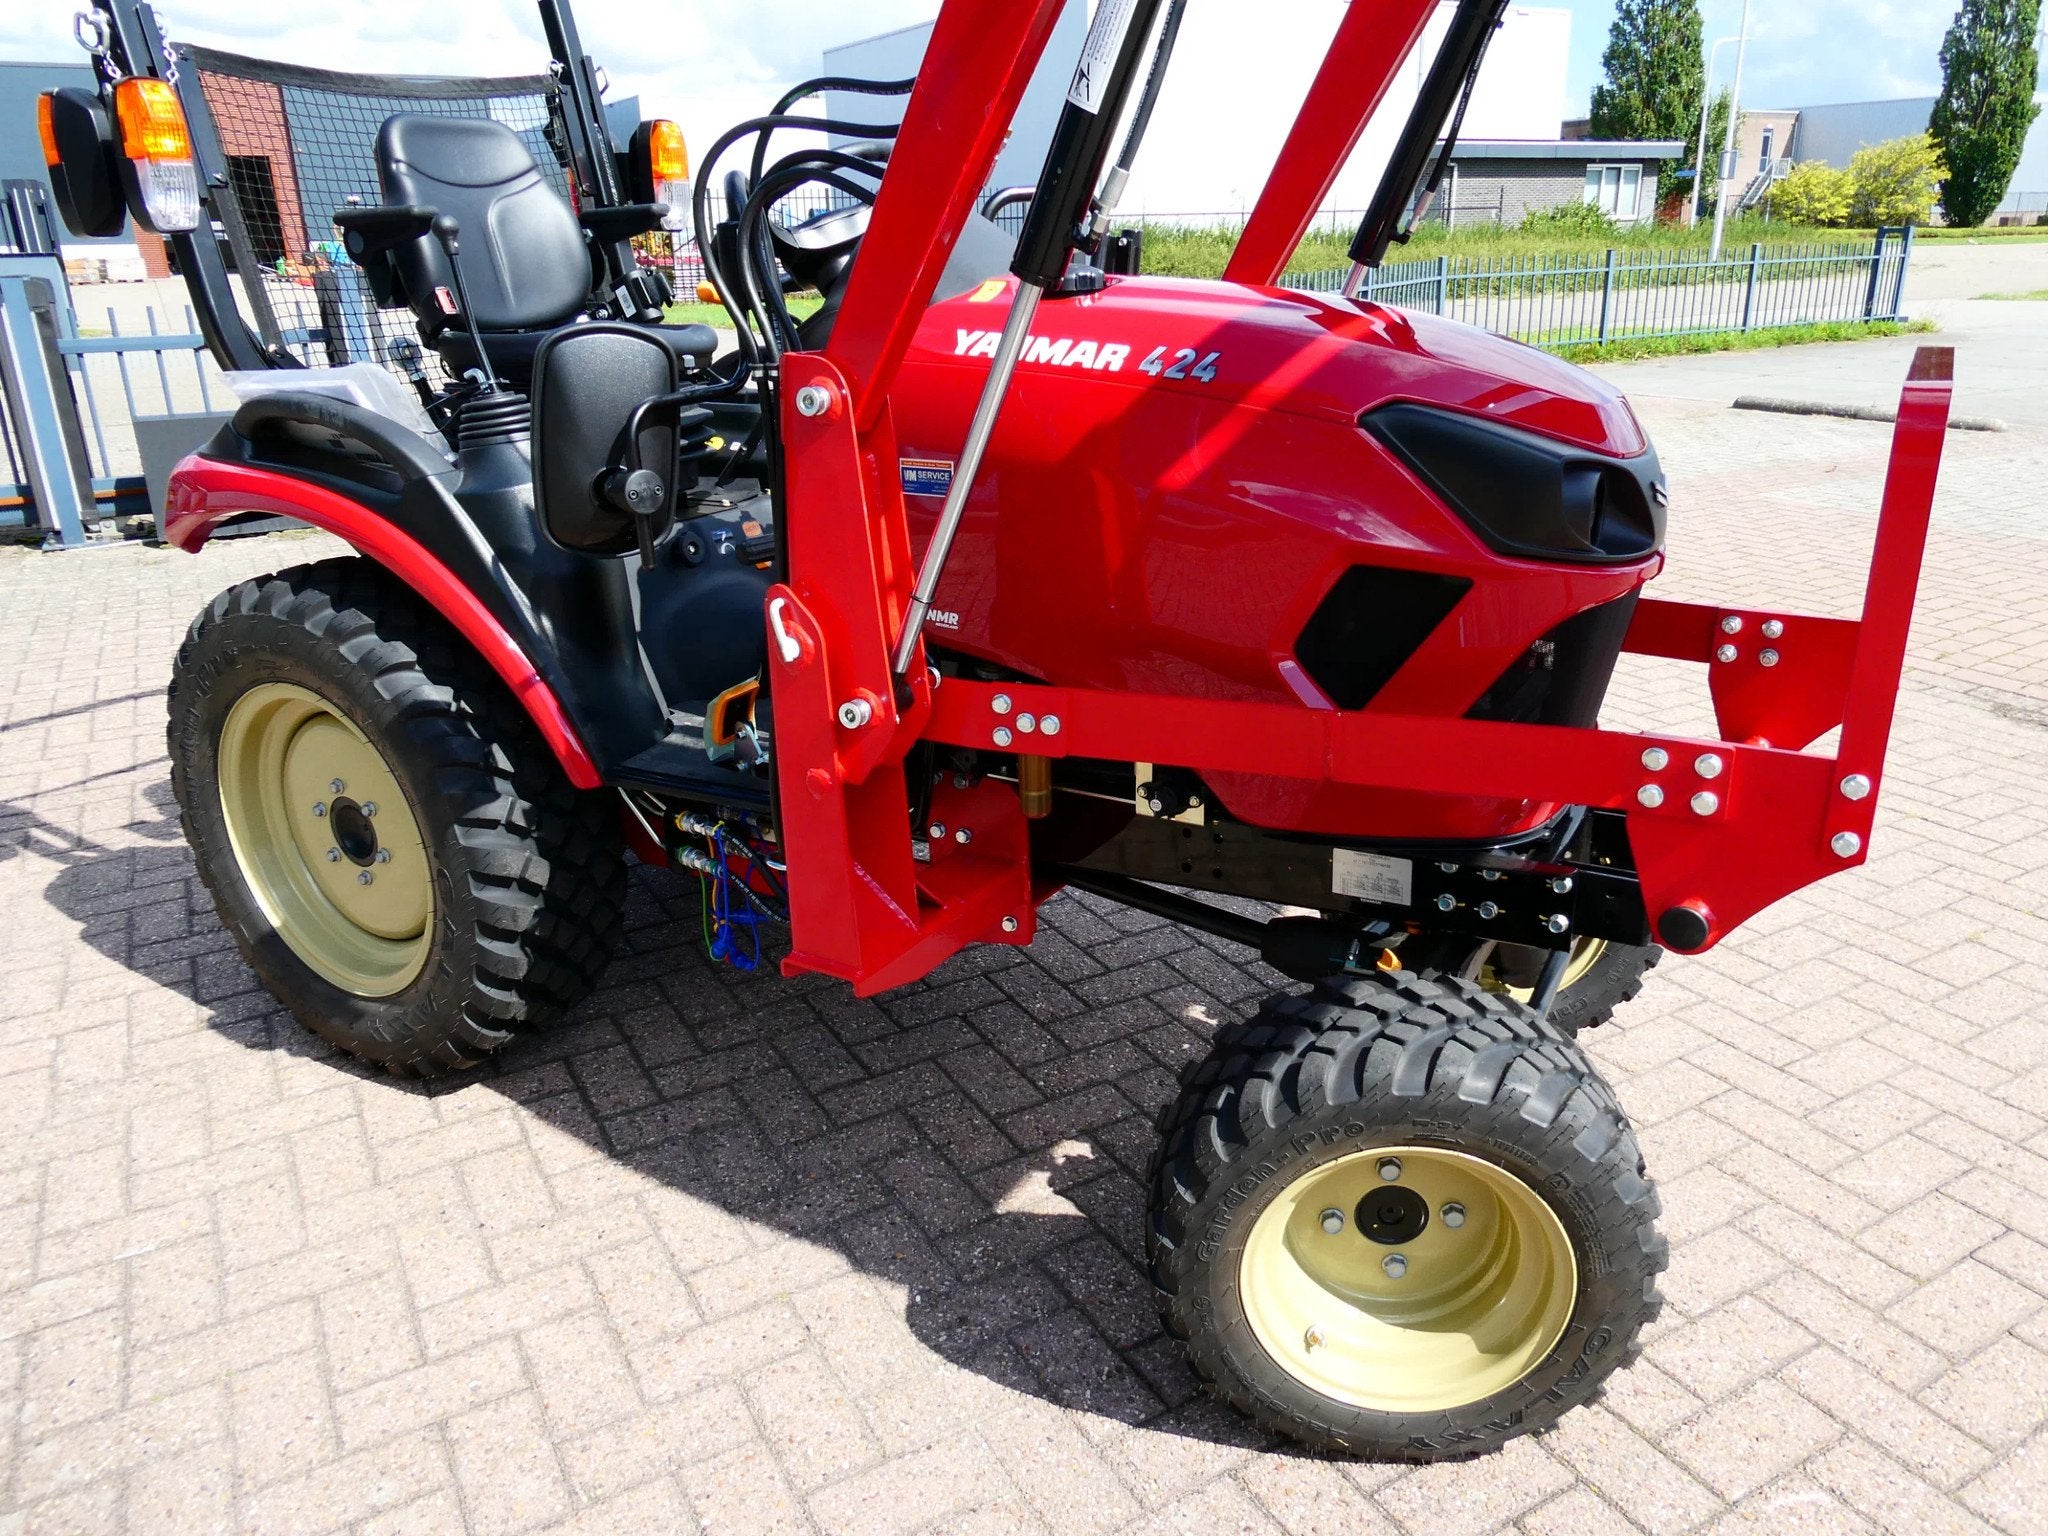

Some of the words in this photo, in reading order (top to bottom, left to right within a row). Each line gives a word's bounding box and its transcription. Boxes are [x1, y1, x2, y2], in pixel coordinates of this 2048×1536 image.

[1138, 346, 1221, 383] 424
[918, 471, 950, 481] SERVICE
[926, 609, 959, 625] NMR
[1400, 1325, 1613, 1450] GALAXY
